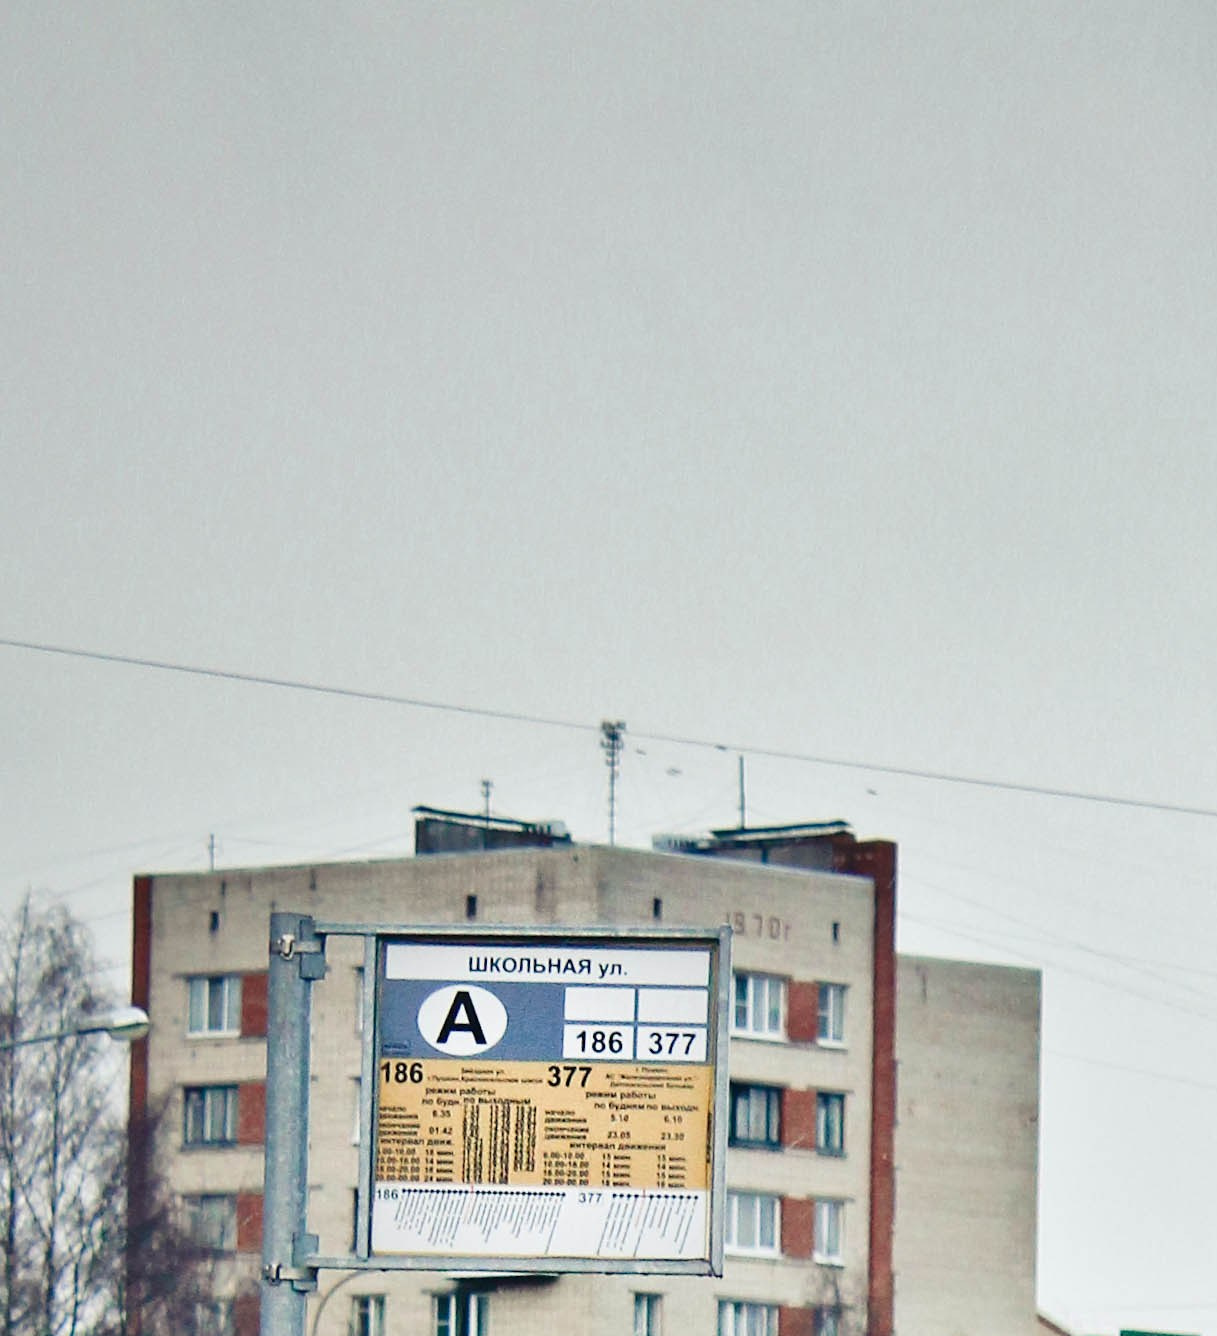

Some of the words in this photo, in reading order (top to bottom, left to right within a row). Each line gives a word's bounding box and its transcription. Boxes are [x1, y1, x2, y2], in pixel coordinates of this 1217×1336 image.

[469, 957, 590, 975] ШКОЛЬНАЯ
[599, 962, 627, 978] ул.
[436, 991, 487, 1044] А
[577, 1032, 623, 1053] 186
[649, 1033, 696, 1054] 377
[381, 1062, 423, 1083] 186
[548, 1066, 592, 1087] 377
[426, 1087, 456, 1096] режим
[460, 1087, 495, 1096] работы
[376, 1189, 398, 1200] 186
[578, 1193, 602, 1204] 377
